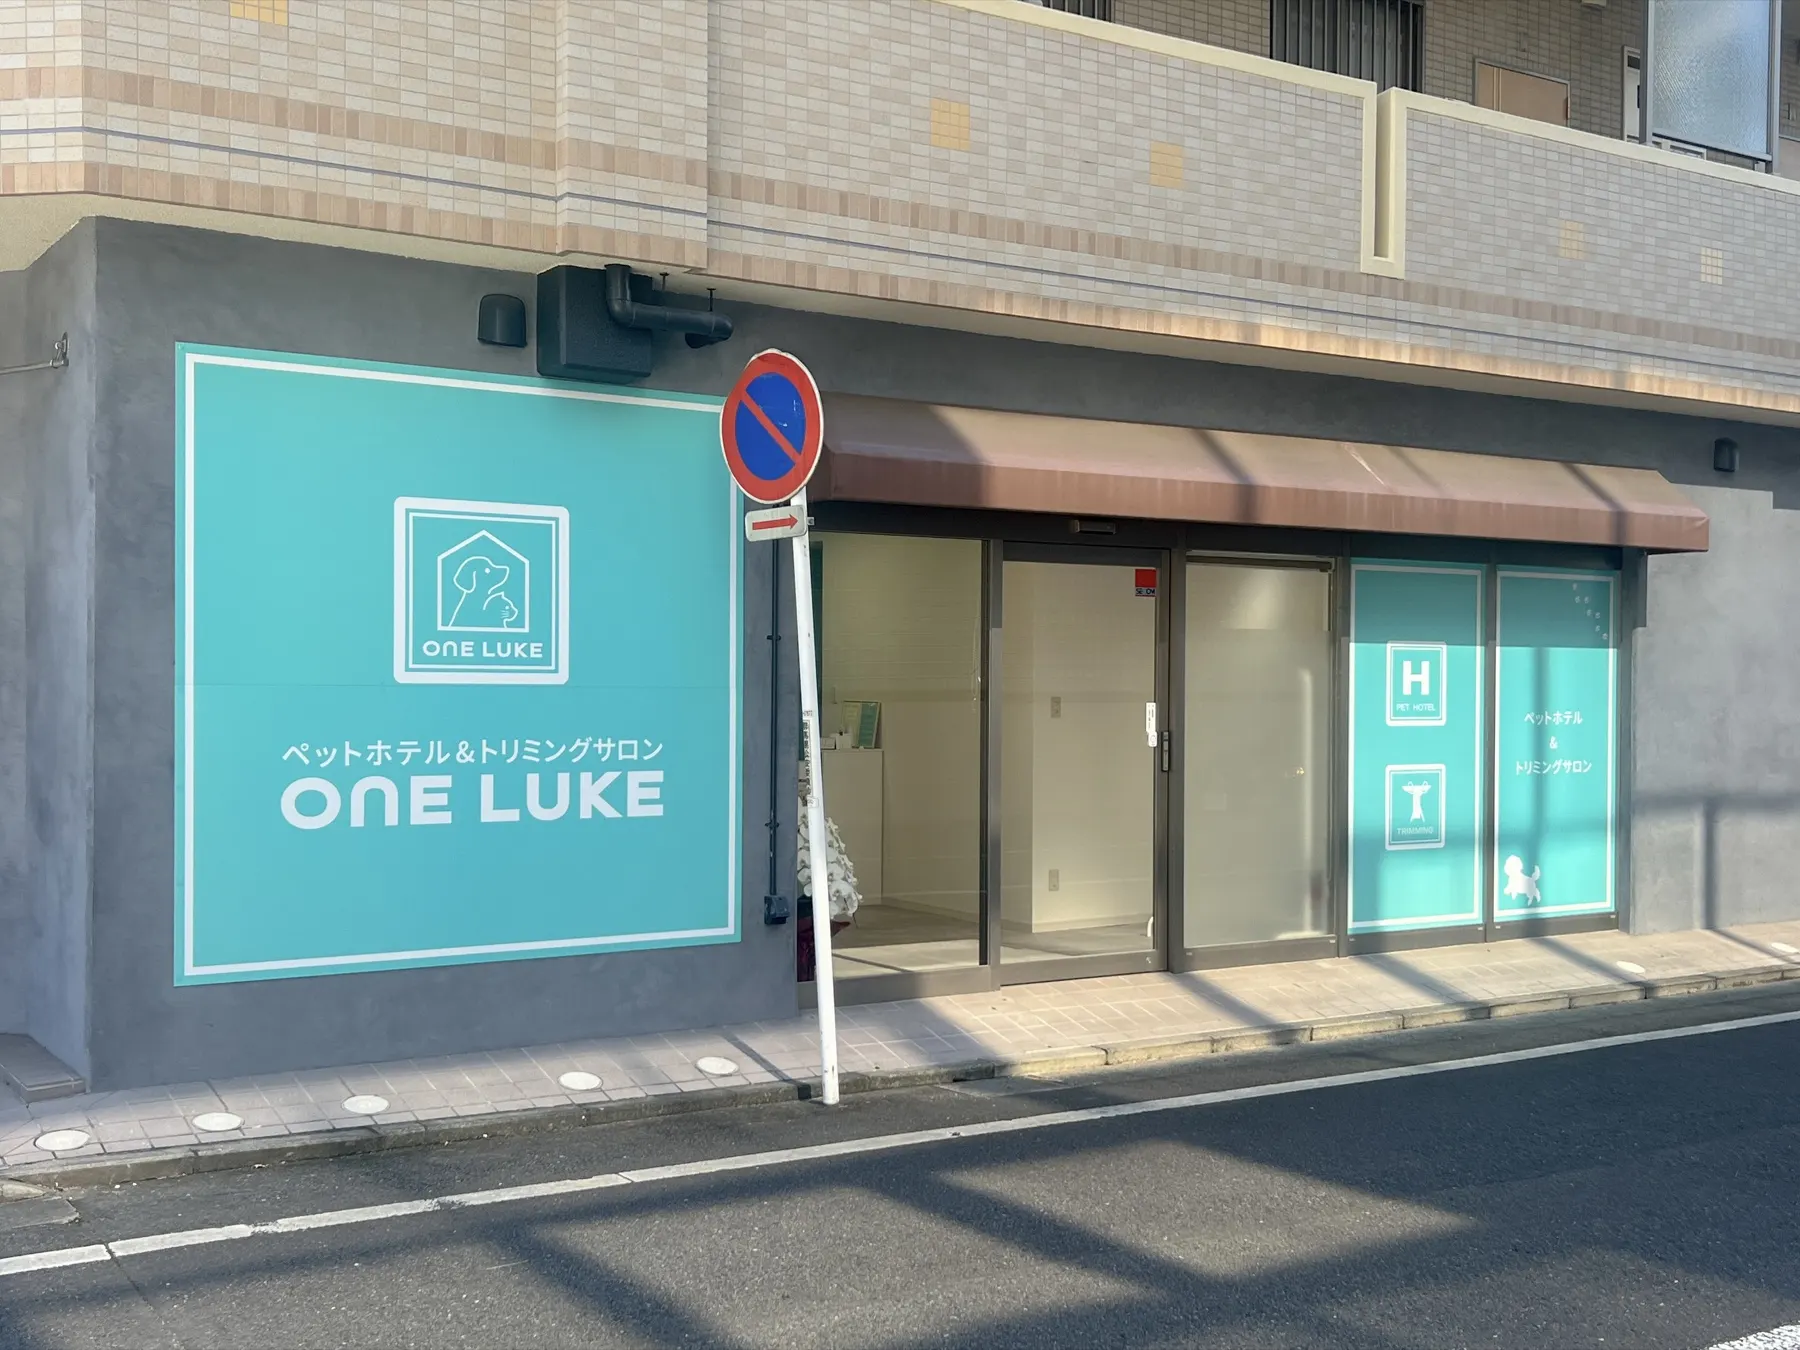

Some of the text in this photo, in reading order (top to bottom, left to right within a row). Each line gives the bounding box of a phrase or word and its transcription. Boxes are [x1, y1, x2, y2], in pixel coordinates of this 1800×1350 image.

[422, 640, 543, 658] ONE LUKE
[1402, 660, 1430, 696] H
[1396, 703, 1436, 712] PET HOTEL
[1524, 710, 1583, 726] ペットホテル
[1549, 735, 1558, 749] &
[1515, 758, 1593, 775] トリミングサロン
[280, 770, 664, 829] ONE LUKE
[1396, 826, 1435, 836] TRIMMING
